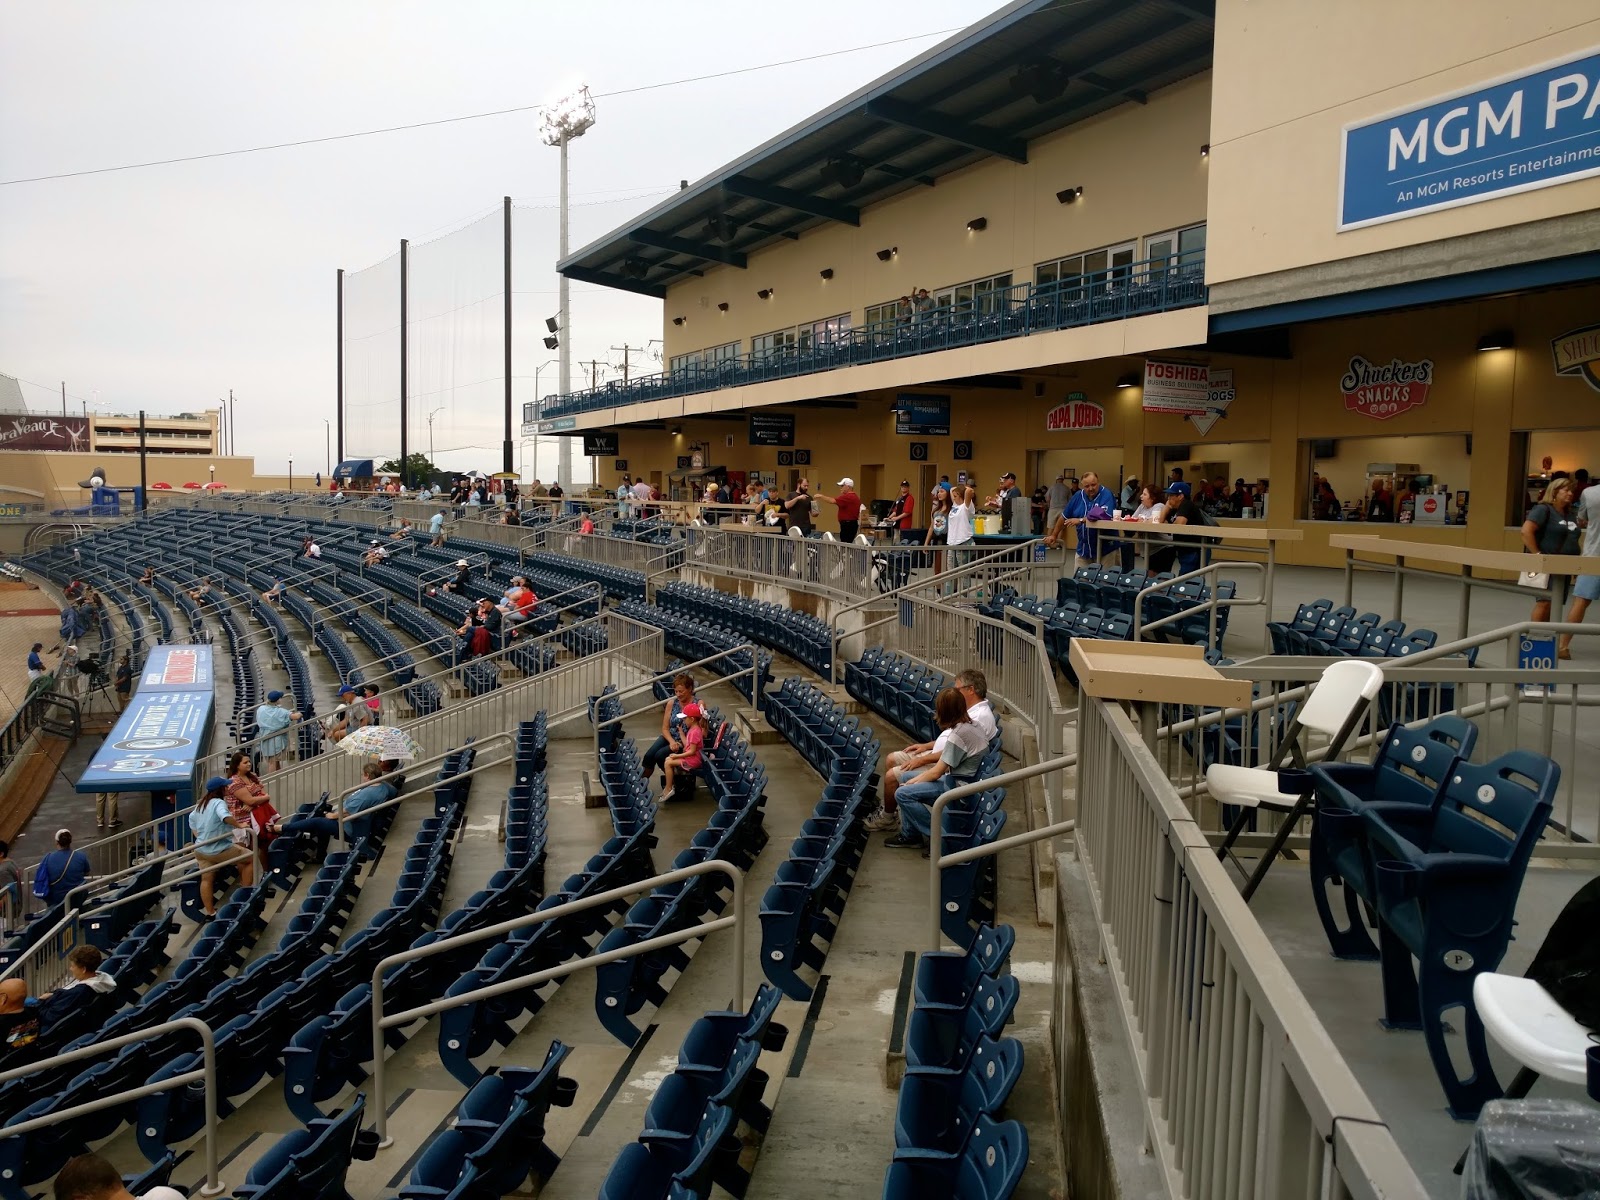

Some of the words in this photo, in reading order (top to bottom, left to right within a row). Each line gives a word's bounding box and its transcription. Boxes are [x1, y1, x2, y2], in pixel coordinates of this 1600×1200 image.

[1387, 89, 1523, 172] MGM
[1397, 190, 1412, 203] An
[1417, 180, 1449, 198] MGM
[1453, 169, 1504, 190] Resorts
[1509, 146, 1600, 177] Entertainme
[1146, 363, 1208, 381] TOSHIBA
[1342, 358, 1431, 391] Shuckers
[1147, 379, 1176, 388] BUSINESS
[1177, 381, 1208, 390] SOLUTIONS
[1208, 380, 1229, 388] LATE
[1358, 386, 1410, 405] SNACKS
[1048, 404, 1071, 429] PAPA
[1522, 656, 1552, 670] 100
[1454, 954, 1463, 964] P
